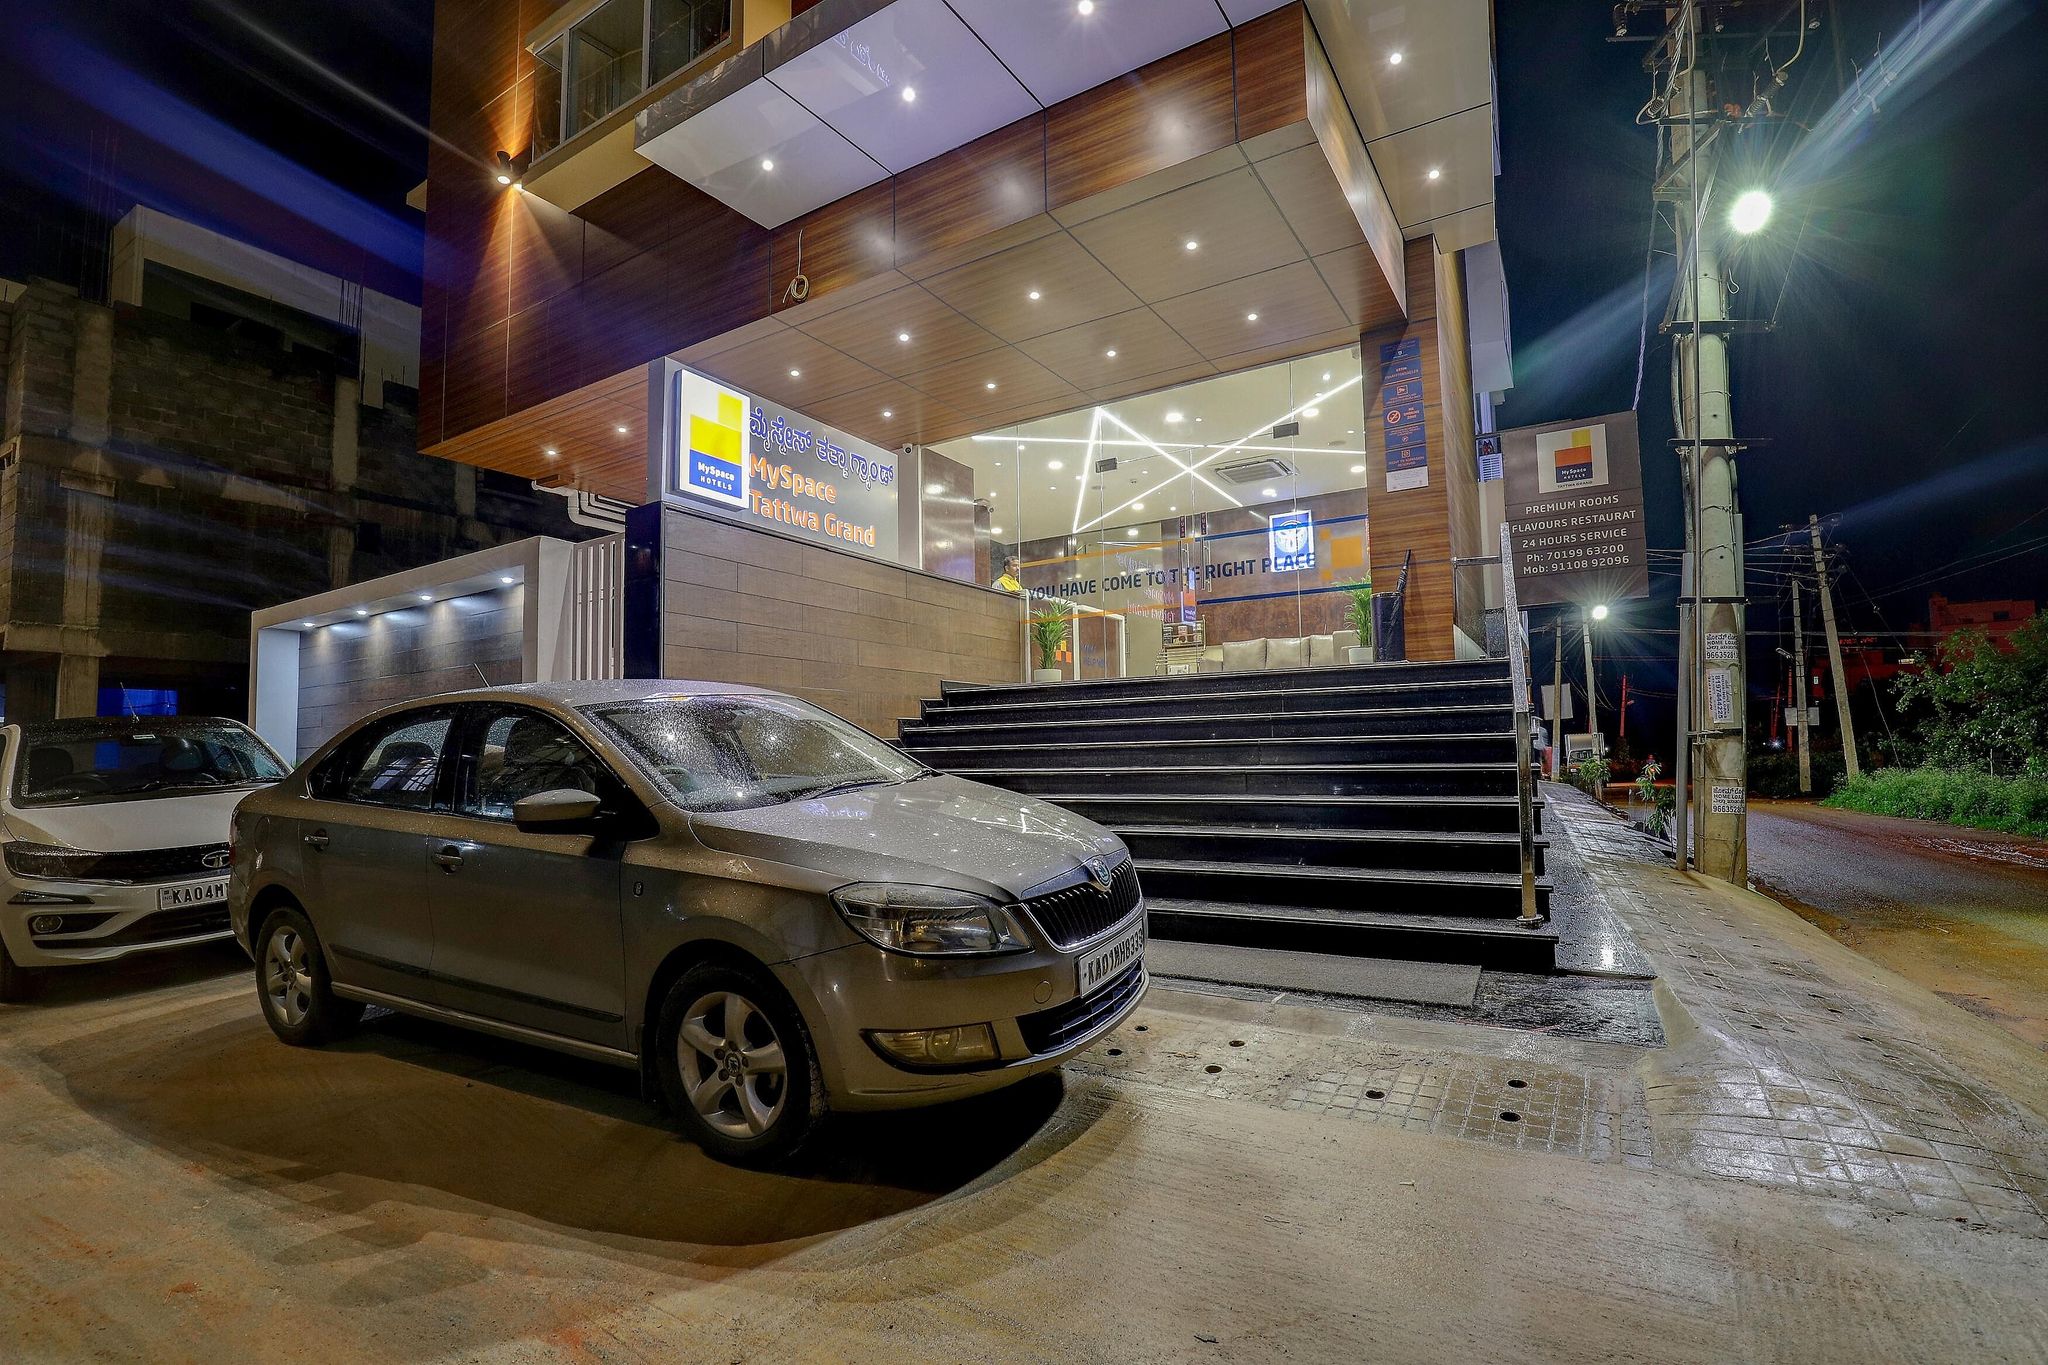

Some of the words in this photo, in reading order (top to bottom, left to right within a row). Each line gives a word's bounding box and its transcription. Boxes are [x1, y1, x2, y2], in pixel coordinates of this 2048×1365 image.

[697, 461, 735, 481] MySpace
[750, 453, 837, 504] MySpace
[700, 475, 733, 491] HOTELS
[1525, 500, 1576, 515] PREMIUM
[1579, 494, 1619, 508] ROOMS
[750, 489, 820, 531] Tattwa
[824, 512, 876, 547] Grand
[1512, 518, 1568, 534] FLAVOURS
[1571, 509, 1637, 526] RESTAURAT
[1522, 539, 1536, 549] 24
[1539, 533, 1577, 546] HOURS
[1580, 527, 1628, 541] SERVICE
[1526, 552, 1544, 563] Ph:
[1546, 548, 1583, 561] 70199
[1586, 543, 1624, 555] 63200
[1523, 564, 1549, 575] Mob:
[1551, 560, 1588, 572] 91108
[1591, 555, 1630, 567] 92096
[1029, 585, 1055, 601] YOU
[1059, 579, 1097, 597] HAVE
[1102, 573, 1142, 592] COME
[1145, 571, 1165, 586] TO
[1205, 559, 1256, 579] RIGHT
[1262, 552, 1316, 573] PLACE
